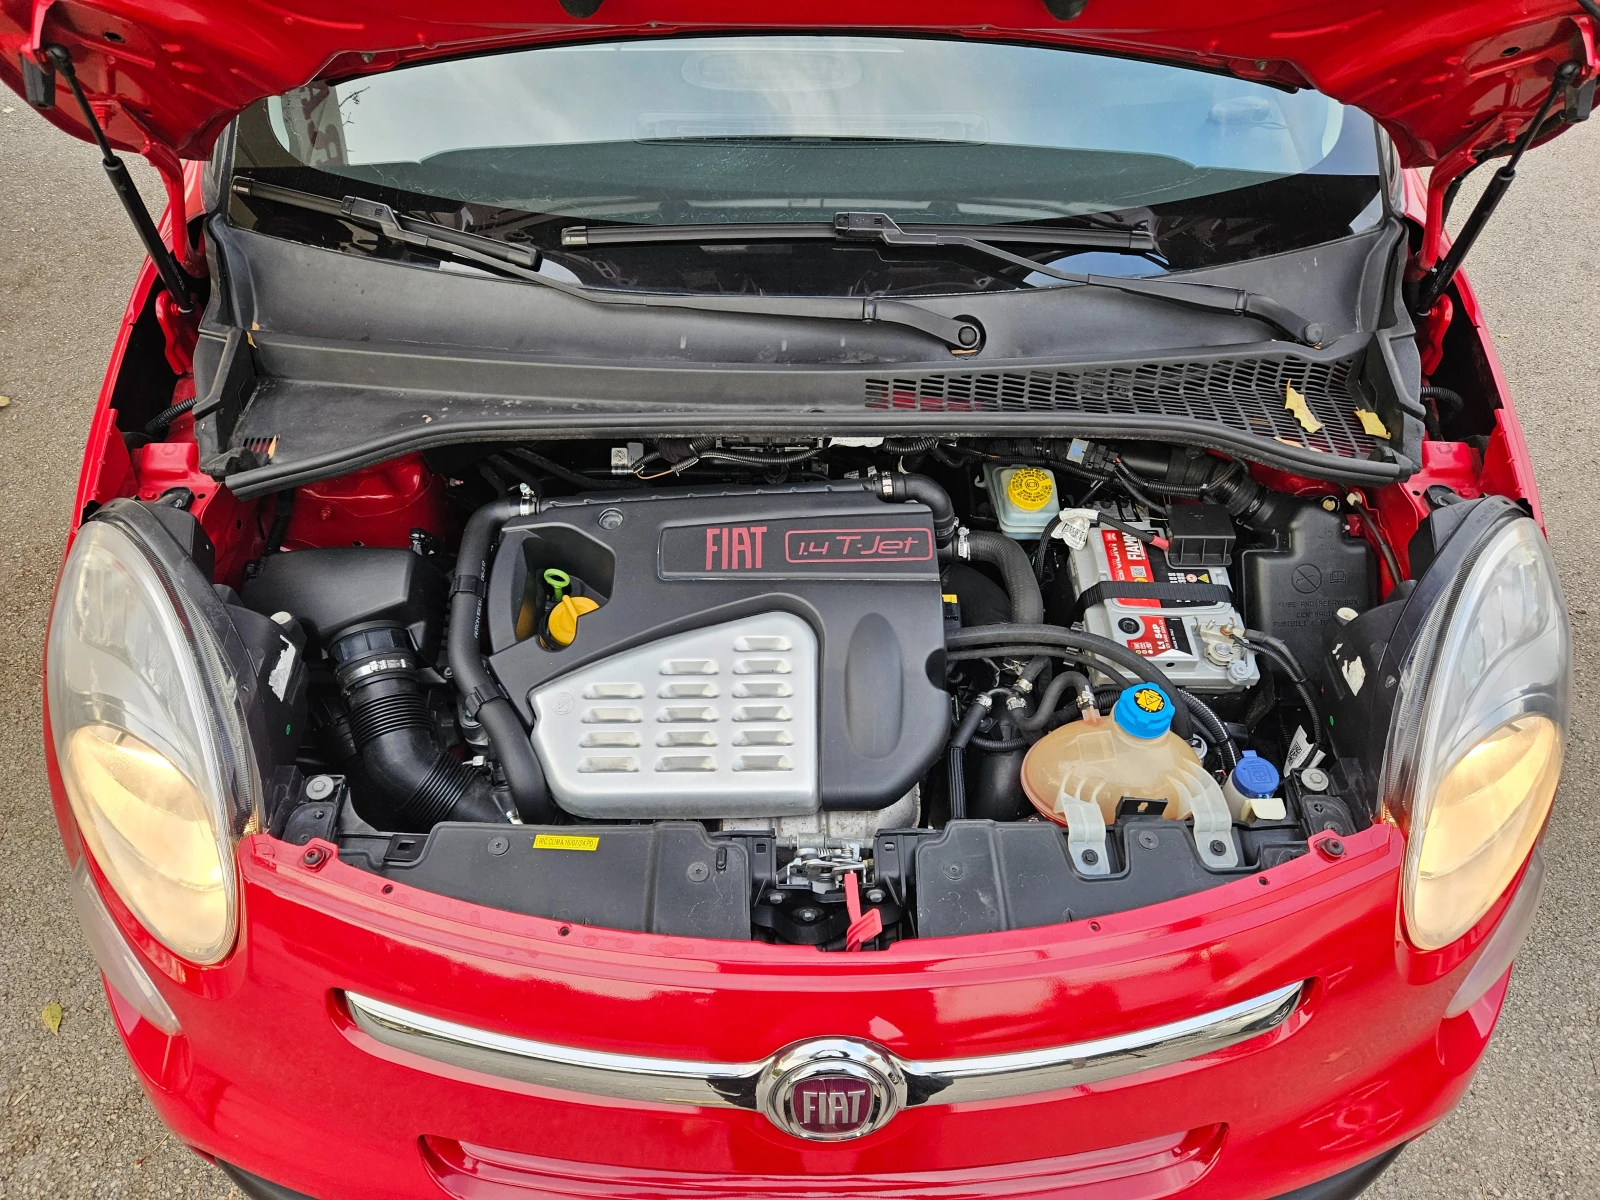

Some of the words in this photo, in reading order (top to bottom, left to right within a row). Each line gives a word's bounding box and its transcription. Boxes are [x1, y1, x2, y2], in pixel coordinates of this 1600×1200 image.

[705, 526, 767, 571] FIAT
[799, 542, 829, 556] 1.4
[1318, 598, 1341, 607] RELAY
[1344, 598, 1359, 606] BOX
[803, 1089, 866, 1125] FIAT
